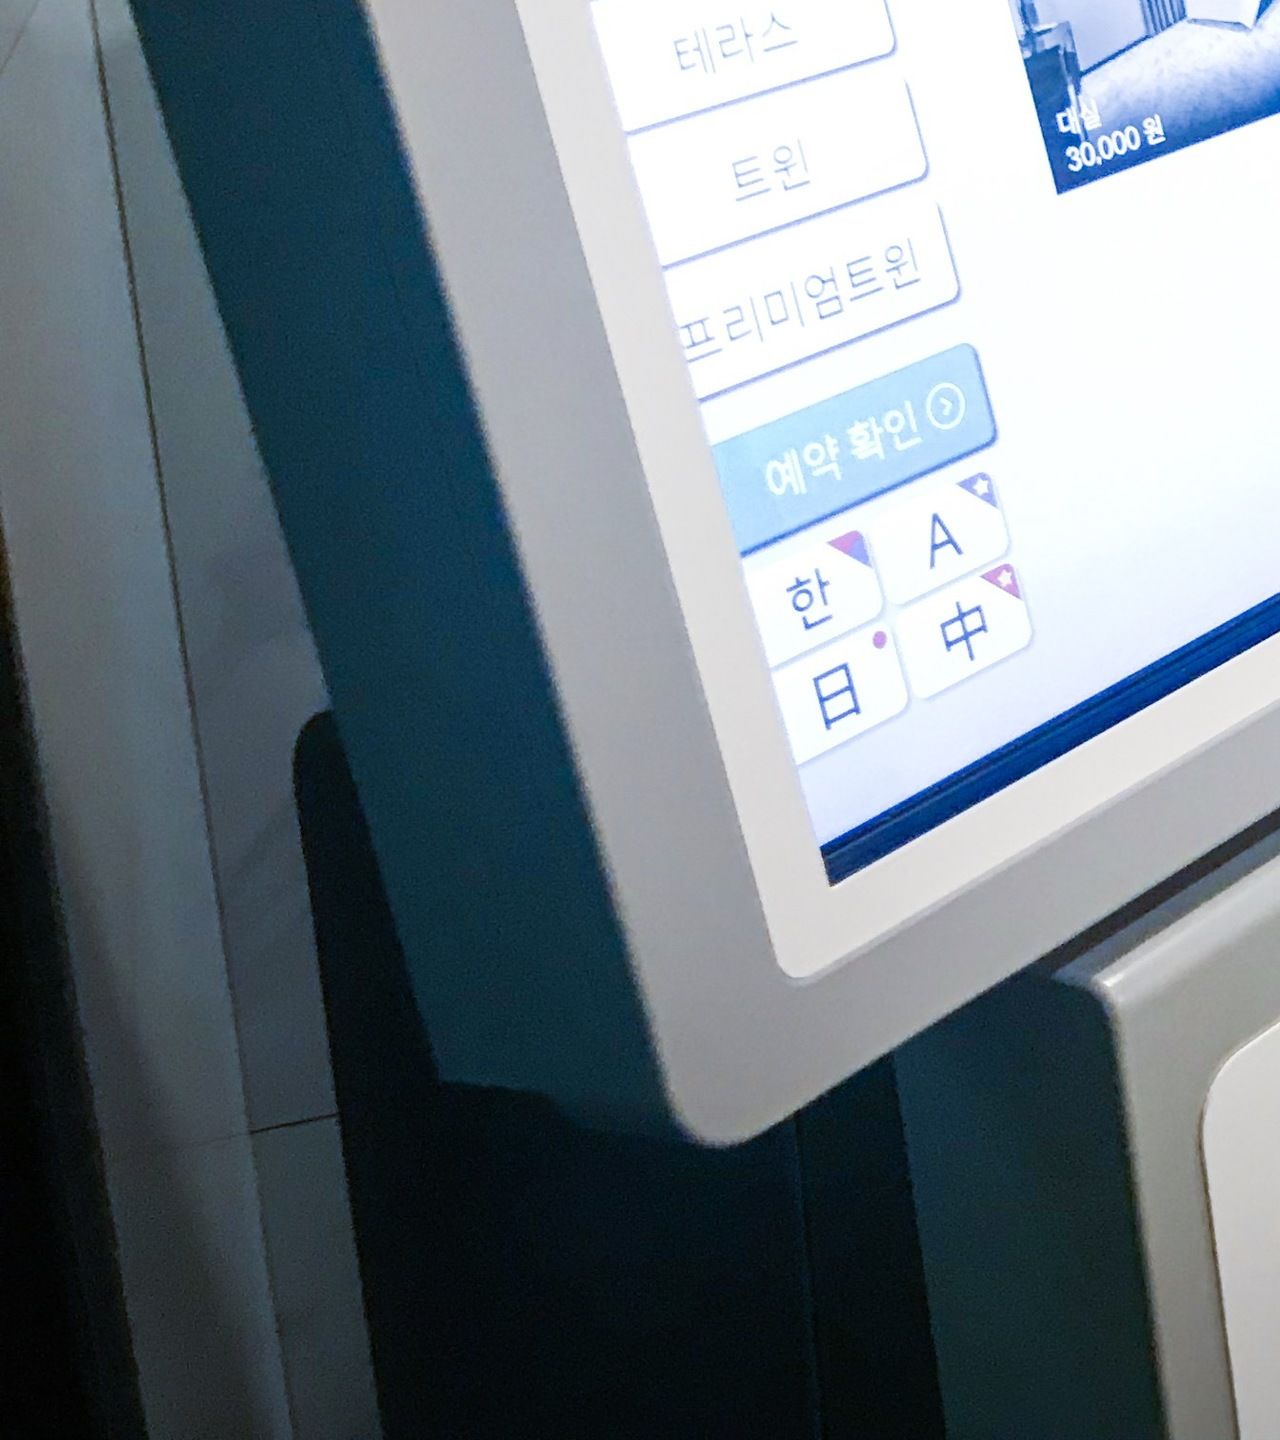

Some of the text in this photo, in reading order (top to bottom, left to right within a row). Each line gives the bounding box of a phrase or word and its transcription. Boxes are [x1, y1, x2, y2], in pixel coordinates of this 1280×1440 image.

[673, 11, 799, 76] 테라스
[733, 138, 811, 204] 트윈
[1065, 126, 1143, 173] 30,000
[680, 238, 921, 363] 프리미엄트윈
[764, 399, 923, 497] 예약 확인
[928, 513, 964, 569] A
[786, 568, 833, 630] 한
[940, 601, 989, 662] 中
[813, 663, 862, 731] 日
